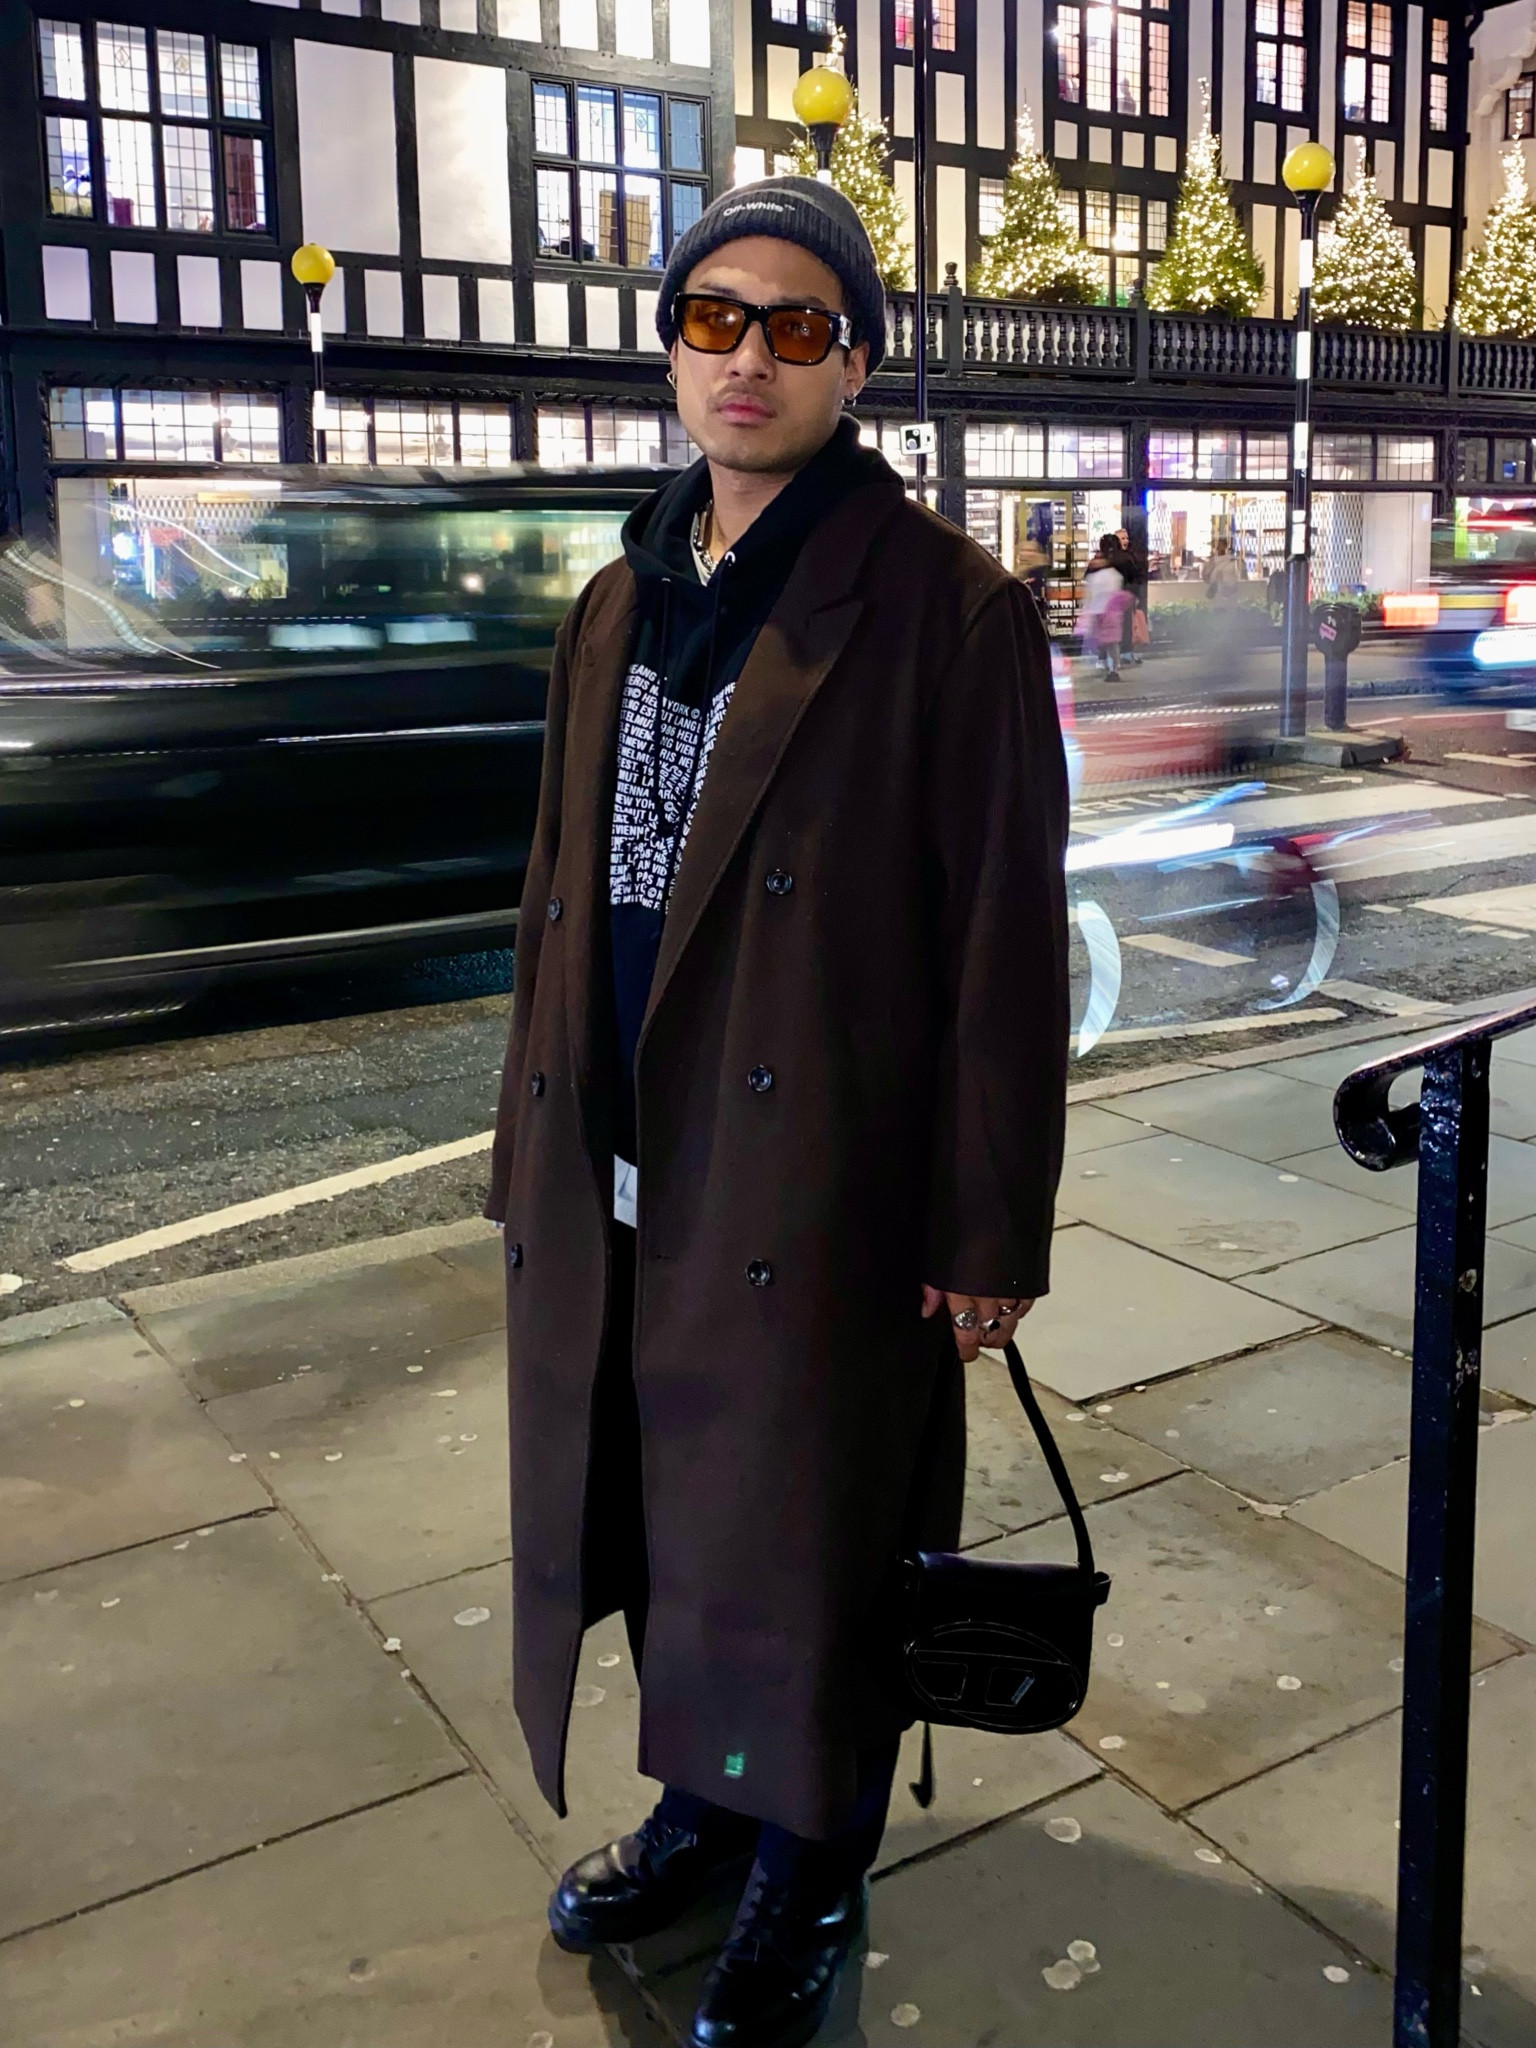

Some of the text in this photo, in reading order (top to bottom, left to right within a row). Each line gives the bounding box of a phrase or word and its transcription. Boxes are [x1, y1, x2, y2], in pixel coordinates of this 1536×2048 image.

[674, 715, 697, 732] LANG
[675, 740, 696, 758] VIEN
[643, 765, 654, 777] 19
[641, 775, 655, 788] LA
